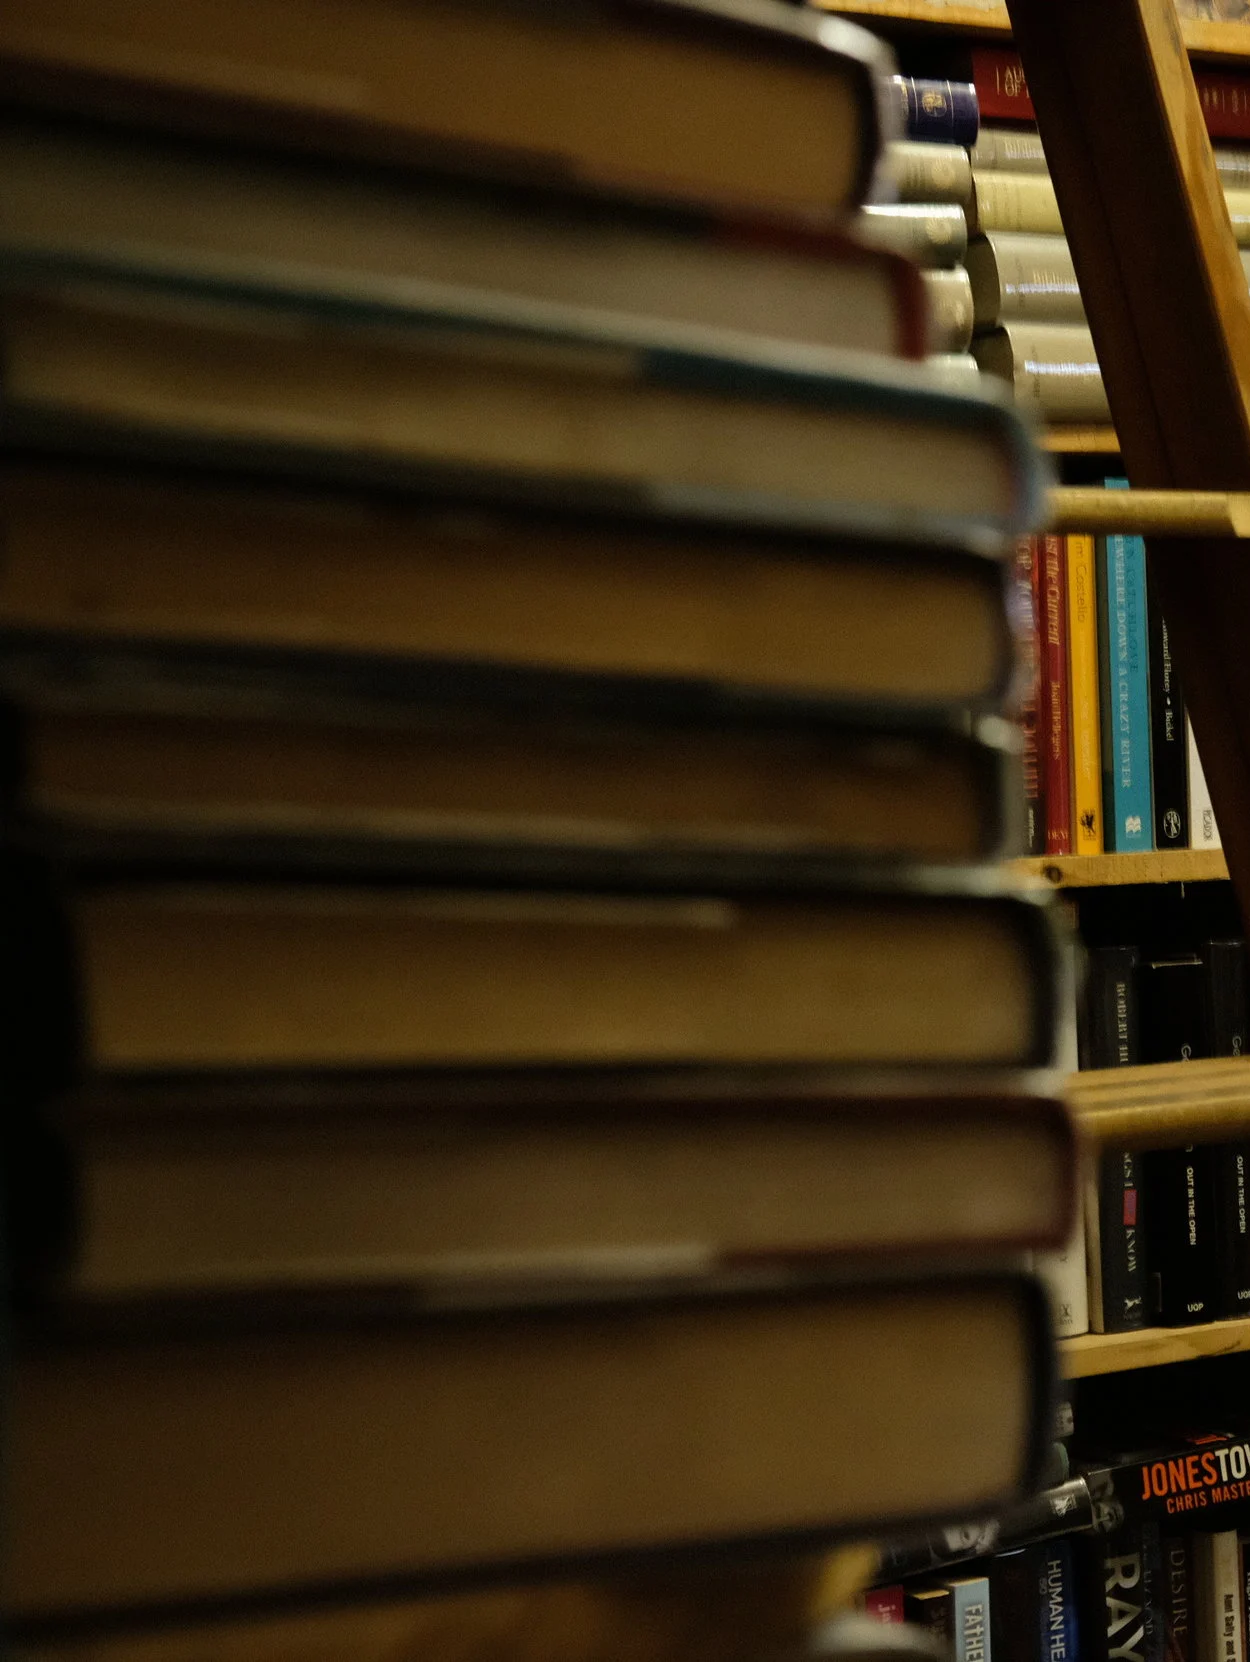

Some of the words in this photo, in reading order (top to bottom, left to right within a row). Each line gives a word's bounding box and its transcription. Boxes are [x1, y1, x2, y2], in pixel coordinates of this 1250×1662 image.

[1114, 538, 1126, 607] EWHERE
[1047, 585, 1062, 646] Current
[1116, 609, 1128, 662] DOWN
[1119, 666, 1128, 679] A
[1119, 681, 1130, 736] CRAZY
[1122, 737, 1132, 790] RIVER
[1202, 809, 1213, 842] PICADOR
[1115, 981, 1128, 1042] ROBERT
[1186, 1166, 1195, 1187] OUT
[1236, 1155, 1245, 1175] OUT
[1187, 1187, 1195, 1198] IN
[1237, 1176, 1245, 1187] IN
[1187, 1198, 1196, 1218] THE
[1237, 1187, 1246, 1207] THE
[1188, 1218, 1198, 1246] OPEN
[1238, 1207, 1247, 1234] OPEN
[1187, 1302, 1204, 1314] UQP
[1165, 1492, 1208, 1516] CHRIS
[1048, 1558, 1067, 1632] HUMAN
[1169, 1550, 1190, 1638] DESIRE
[1223, 1615, 1236, 1639] Sally
[1225, 1640, 1236, 1656] and
